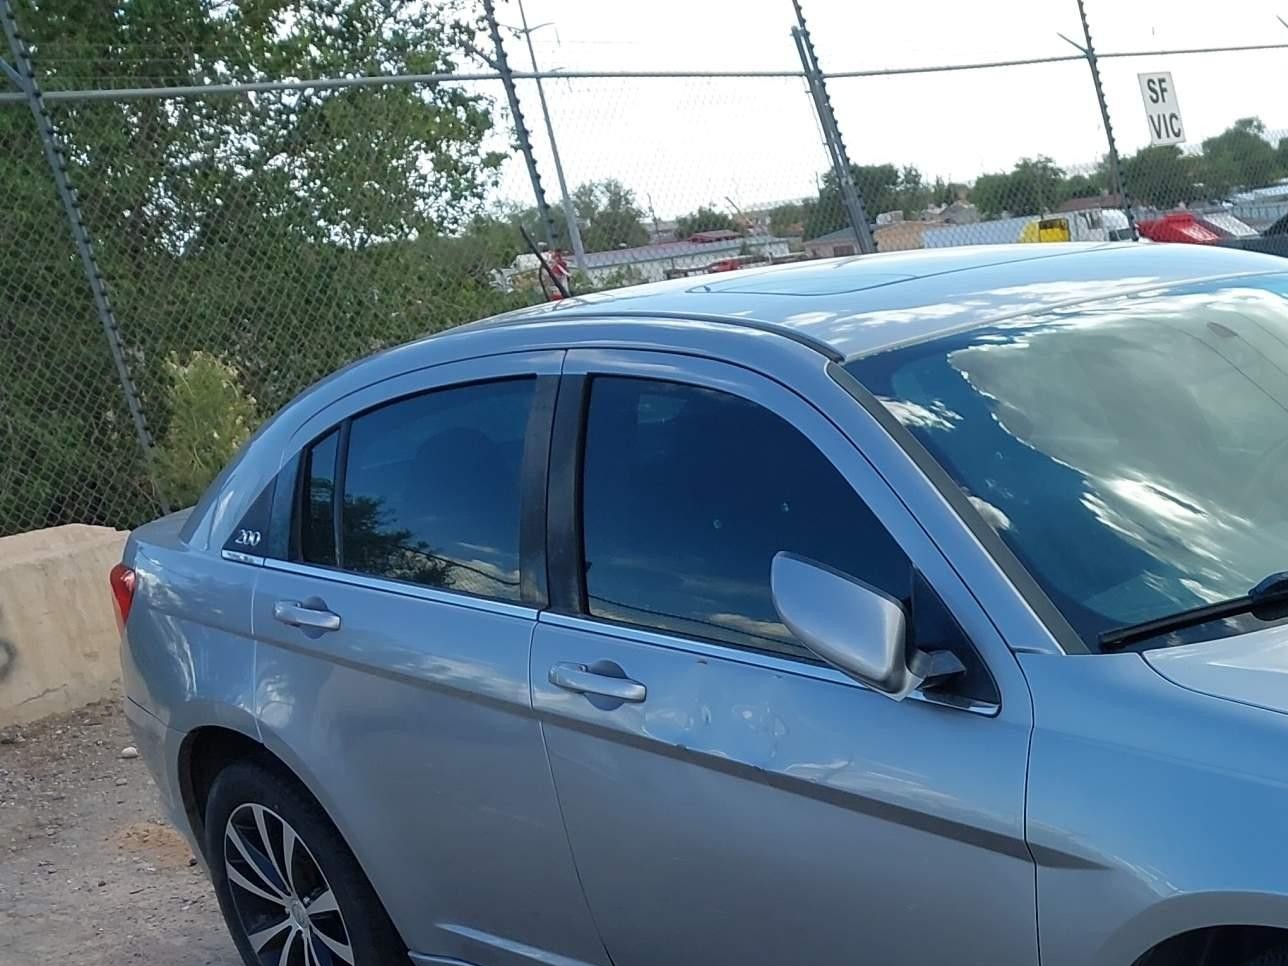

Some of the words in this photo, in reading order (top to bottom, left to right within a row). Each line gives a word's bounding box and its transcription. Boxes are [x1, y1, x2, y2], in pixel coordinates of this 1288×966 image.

[1147, 78, 1168, 104] SF
[1149, 112, 1181, 139] VIC
[235, 529, 261, 546] 200
